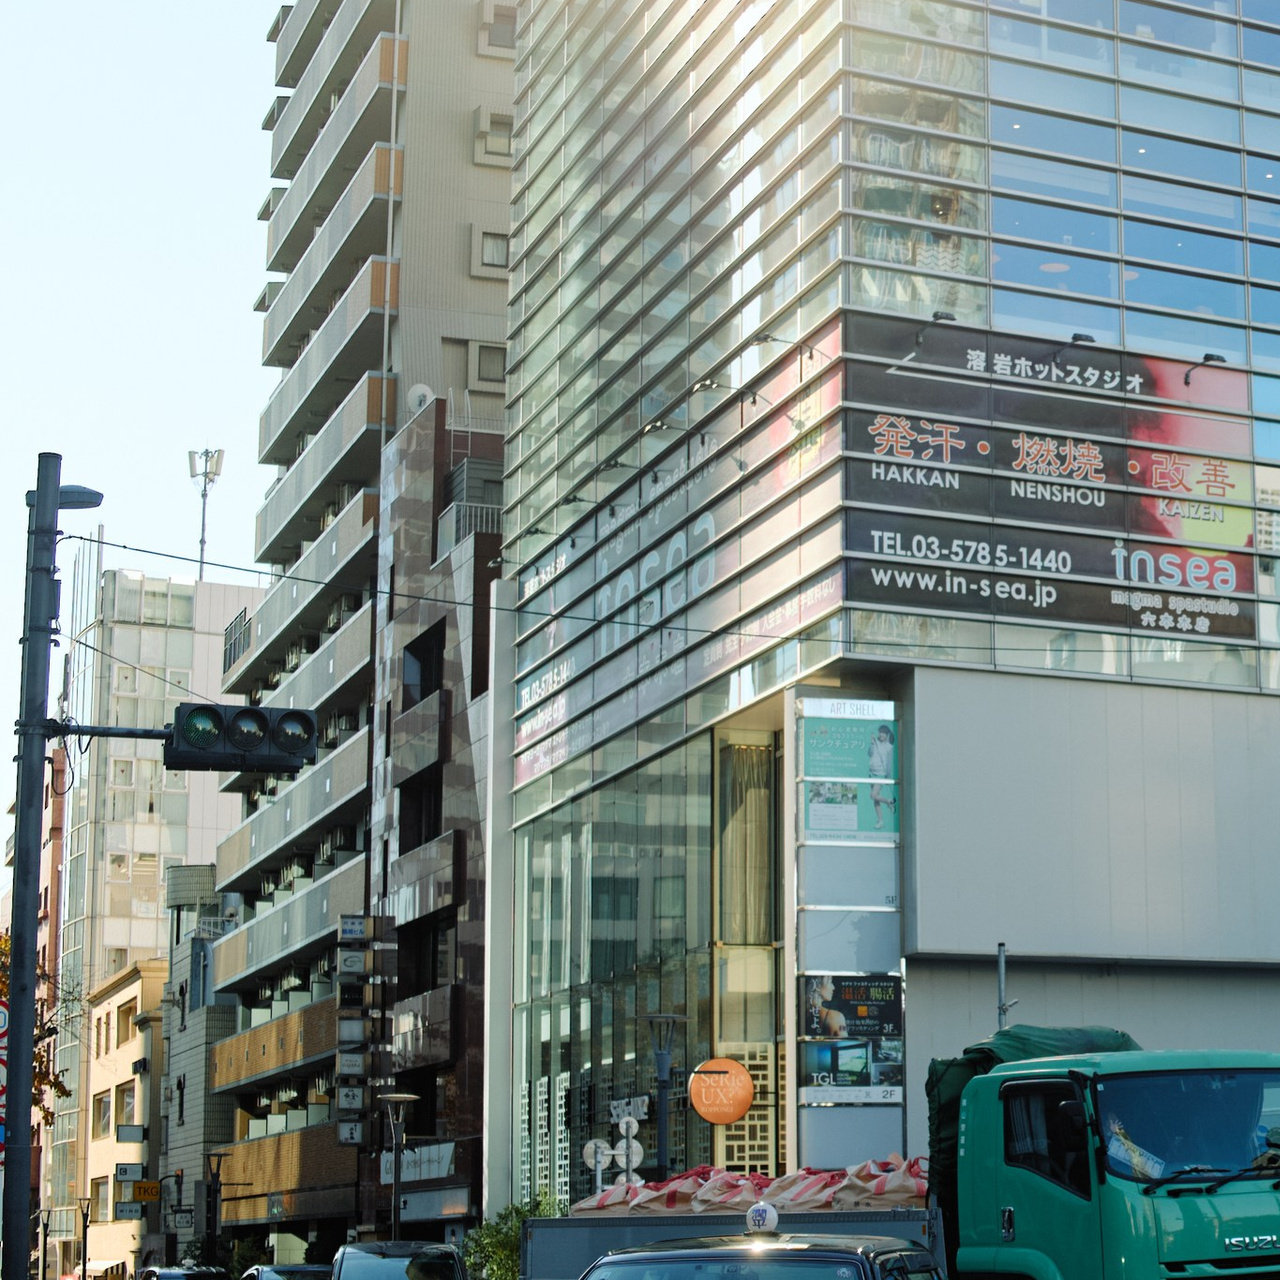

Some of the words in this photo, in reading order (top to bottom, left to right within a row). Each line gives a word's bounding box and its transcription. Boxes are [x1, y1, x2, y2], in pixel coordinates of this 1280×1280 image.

[966, 348, 1144, 394] 溶岩ホットスタジオ
[871, 462, 960, 490] HAKKAN
[1010, 481, 1106, 508] NENSHOU
[1158, 498, 1224, 523] KAIZEN
[1111, 539, 1236, 592] insea
[870, 567, 1057, 608] www.in-sea.jp
[1111, 590, 1162, 611] magma
[1169, 595, 1239, 616] spastudio
[1141, 611, 1210, 634] 六本木店
[830, 702, 847, 715] ART
[850, 703, 876, 716] SHELL
[810, 738, 866, 750] サンクチュアリ
[883, 1023, 894, 1034] 3F
[811, 1072, 836, 1085] TGL
[882, 1089, 896, 1099] 2F
